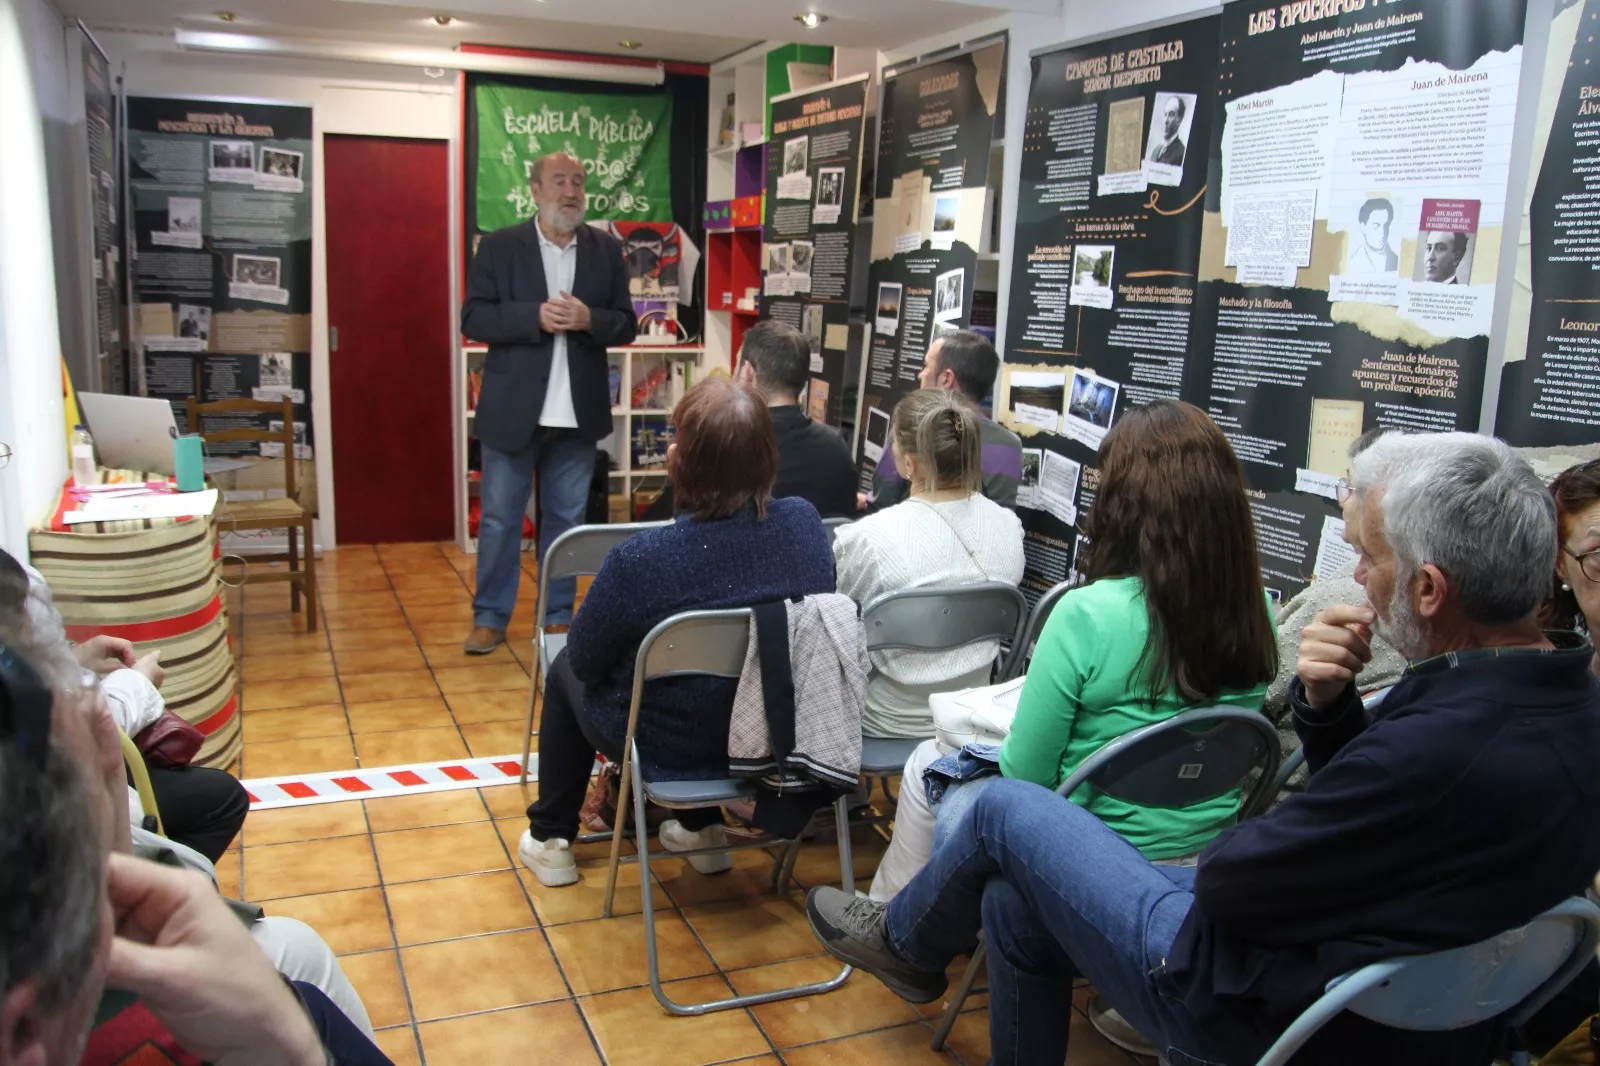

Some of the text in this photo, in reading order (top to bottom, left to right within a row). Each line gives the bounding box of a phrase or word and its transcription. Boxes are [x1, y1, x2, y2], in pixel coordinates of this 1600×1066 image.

[1248, 8, 1276, 36] LOS
[1300, 32, 1318, 45] Abel
[1345, 26, 1352, 38] y
[1352, 21, 1374, 34] Juan
[1374, 18, 1386, 30] de
[1386, 11, 1423, 28] Mairena
[1066, 40, 1184, 81] CAMPOS DE CASTILLA
[1113, 65, 1161, 89] DESPIERTO
[1411, 72, 1489, 91] Juan de Mairena
[1580, 86, 1600, 100] Ele
[1236, 102, 1251, 112] Abel
[504, 109, 654, 143] ESCUELA PÚBLICA
[1574, 130, 1599, 138] Escritora,
[1076, 223, 1086, 232] Los
[1104, 222, 1111, 231] de
[1121, 222, 1135, 231] obra
[1119, 284, 1144, 294] Rechazo
[1145, 285, 1154, 295] del
[1126, 294, 1135, 302] del
[1137, 294, 1159, 303] hombre
[1219, 296, 1293, 310] Machado y la filosofía
[1560, 317, 1600, 332] Leonor
[1577, 337, 1590, 345] 1907,
[1381, 351, 1460, 368] Juan de Mairena.
[1542, 352, 1566, 360] diciembre
[1574, 354, 1588, 362] dicho
[1362, 358, 1459, 379] Sentencias, donaires,
[1352, 369, 1458, 389] apuntes y recuerdos de
[1361, 379, 1456, 399] un profesor apócrifo.
[1436, 410, 1457, 418] aparecido
[1567, 407, 1592, 416] Machado,
[1567, 416, 1586, 424] esposa,
